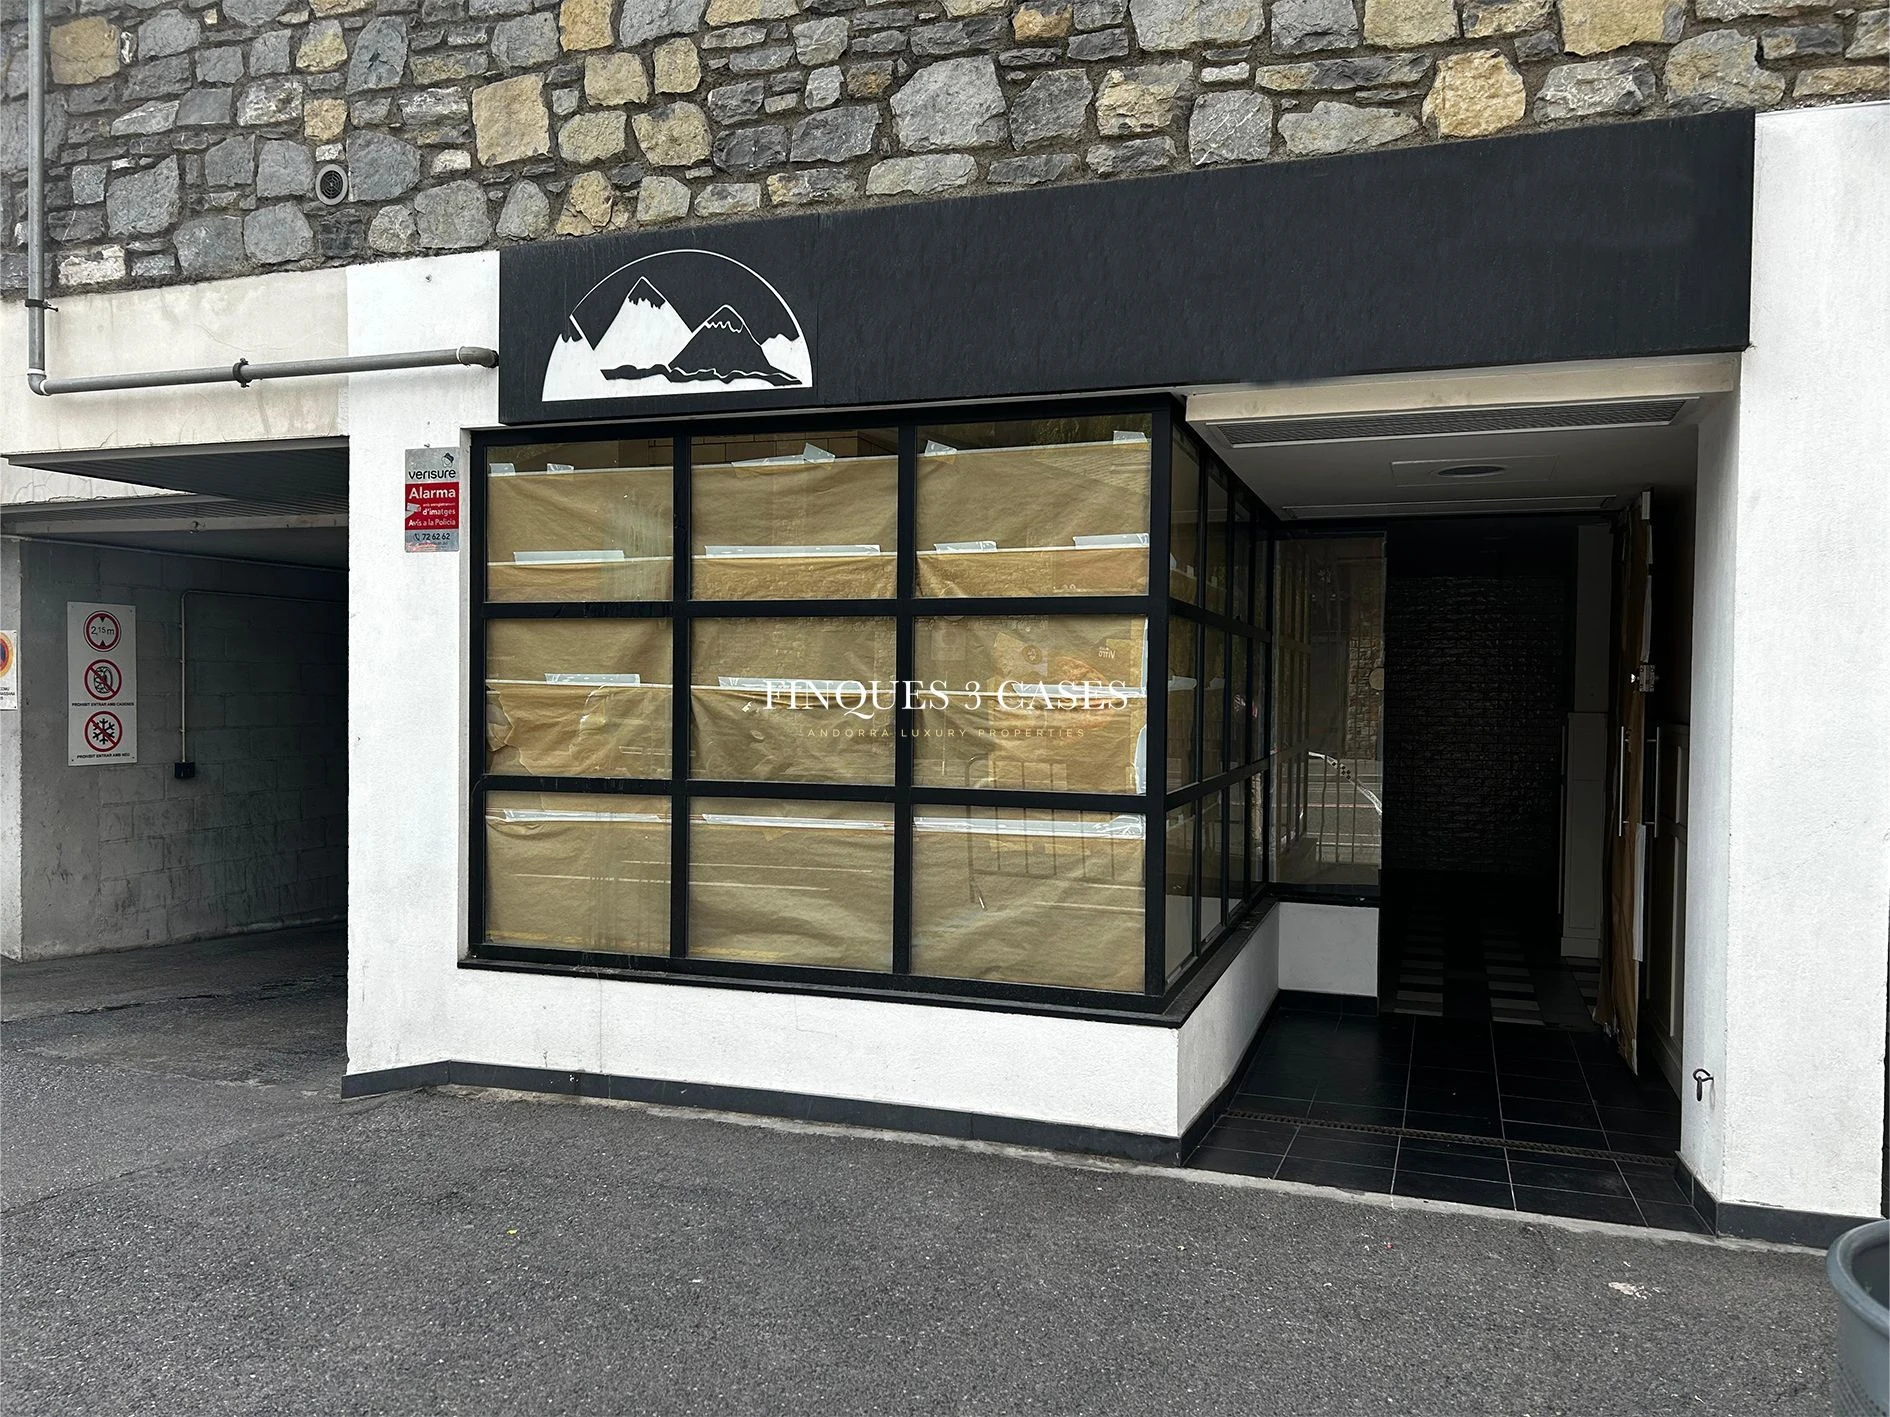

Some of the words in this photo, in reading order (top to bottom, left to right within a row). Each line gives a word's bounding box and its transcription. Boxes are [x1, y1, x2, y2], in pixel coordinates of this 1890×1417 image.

[408, 469, 456, 480] verisure
[408, 486, 456, 499] Alarma
[422, 508, 456, 517] d'imatges
[428, 518, 434, 526] la
[421, 533, 431, 541] 72
[431, 532, 441, 541] 62
[441, 532, 451, 540] 62
